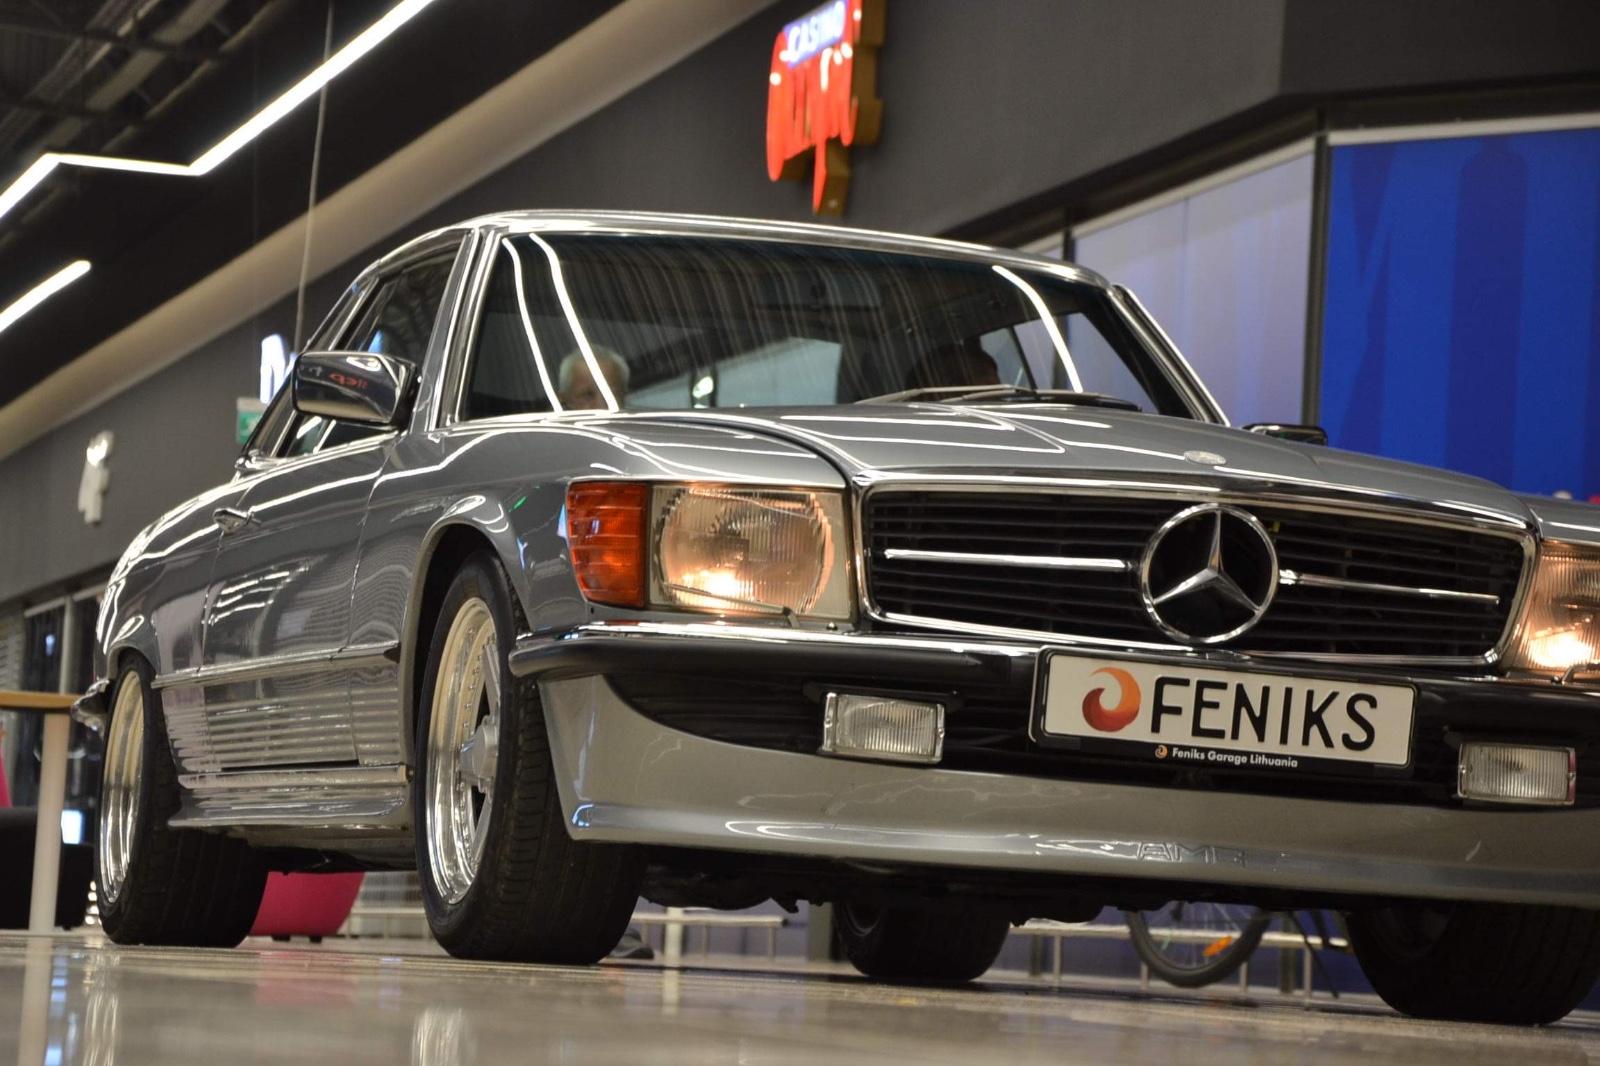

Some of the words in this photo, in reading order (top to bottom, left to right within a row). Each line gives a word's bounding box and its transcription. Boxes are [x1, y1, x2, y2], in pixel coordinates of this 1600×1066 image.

[1150, 675, 1378, 752] FENIKS
[1172, 747, 1205, 761] Feniks
[1207, 751, 1248, 766] Garage
[1249, 754, 1298, 768] Lithuania
